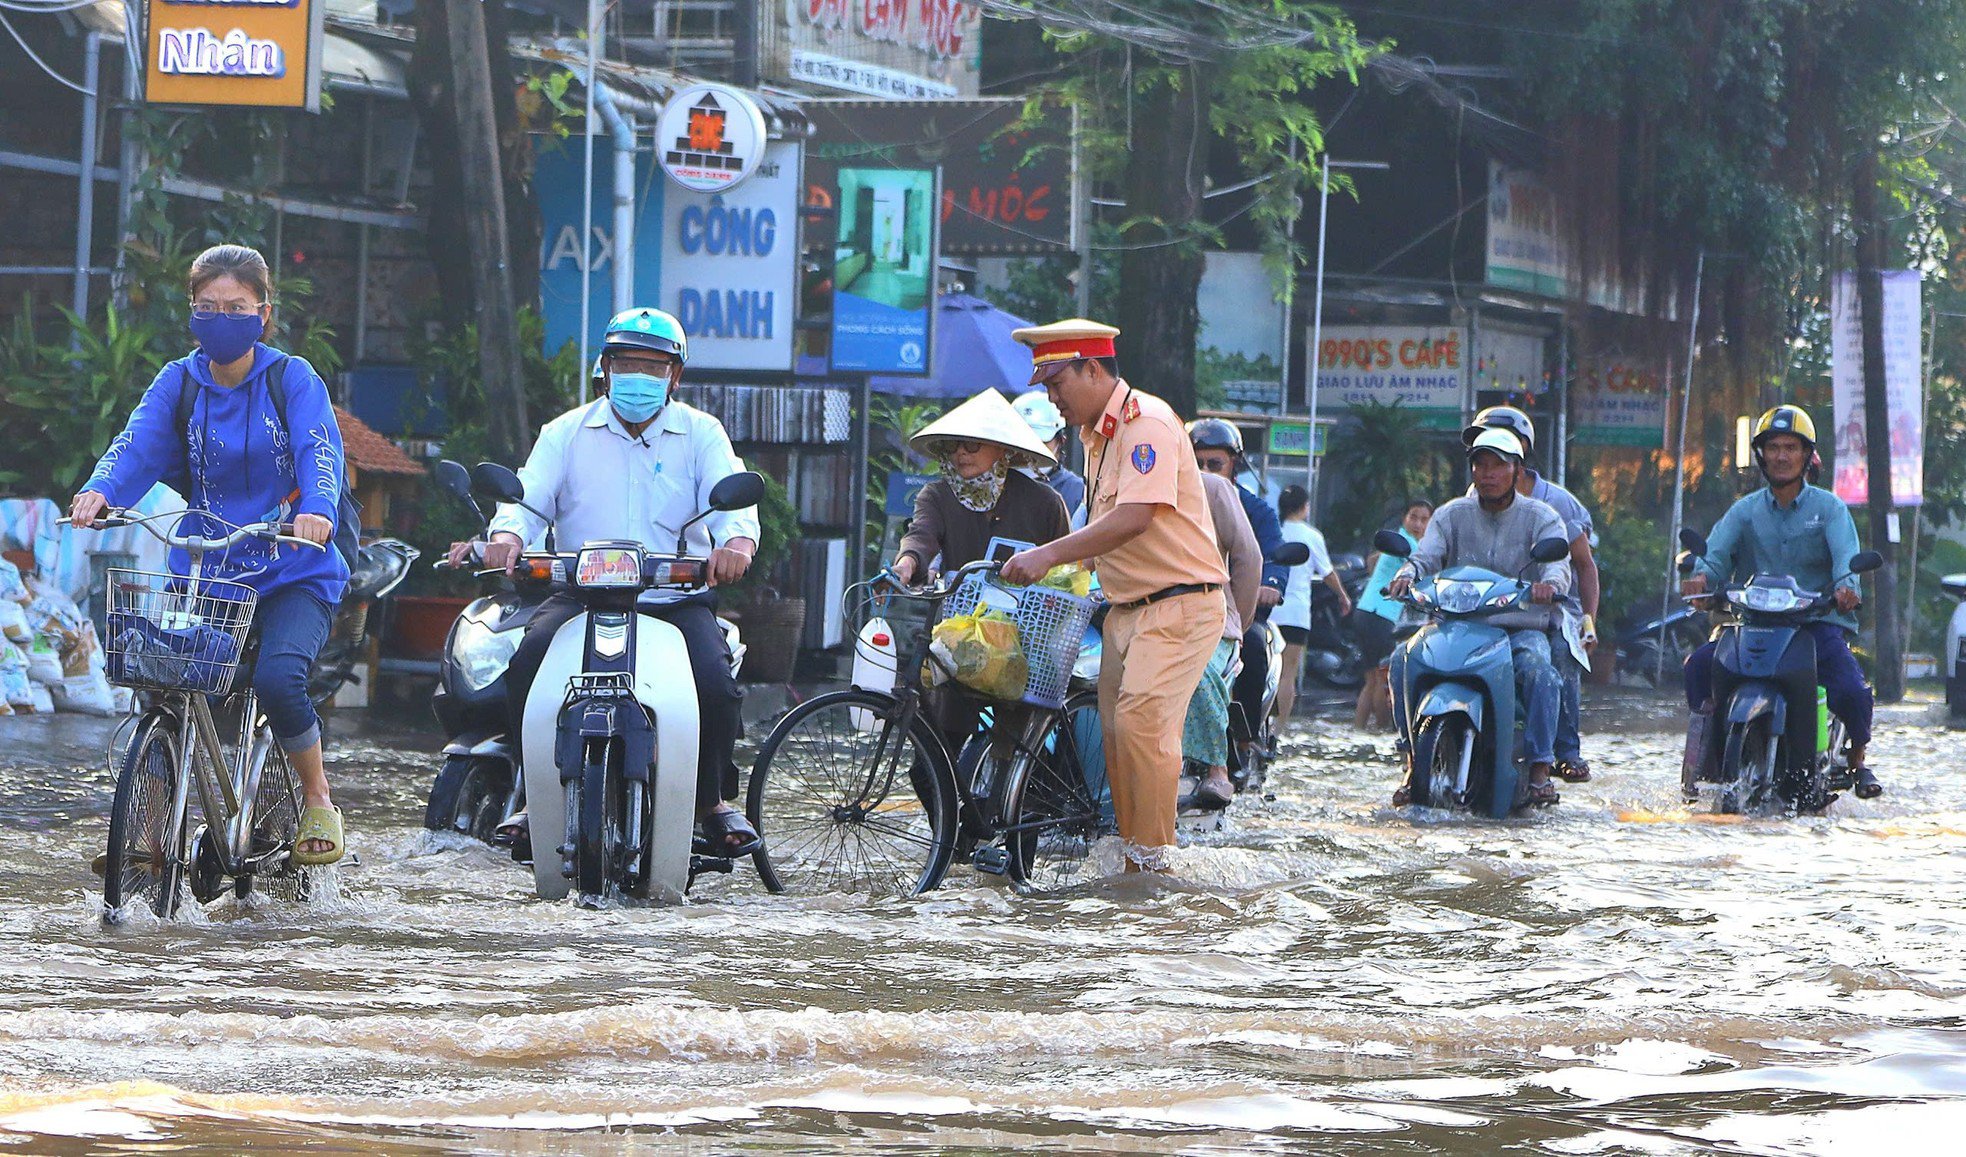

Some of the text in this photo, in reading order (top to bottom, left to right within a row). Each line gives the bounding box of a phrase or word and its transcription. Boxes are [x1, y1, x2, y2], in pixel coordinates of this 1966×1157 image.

[161, 28, 284, 76] Nhân
[680, 194, 777, 257] CÔNG
[679, 287, 774, 340] DANH
